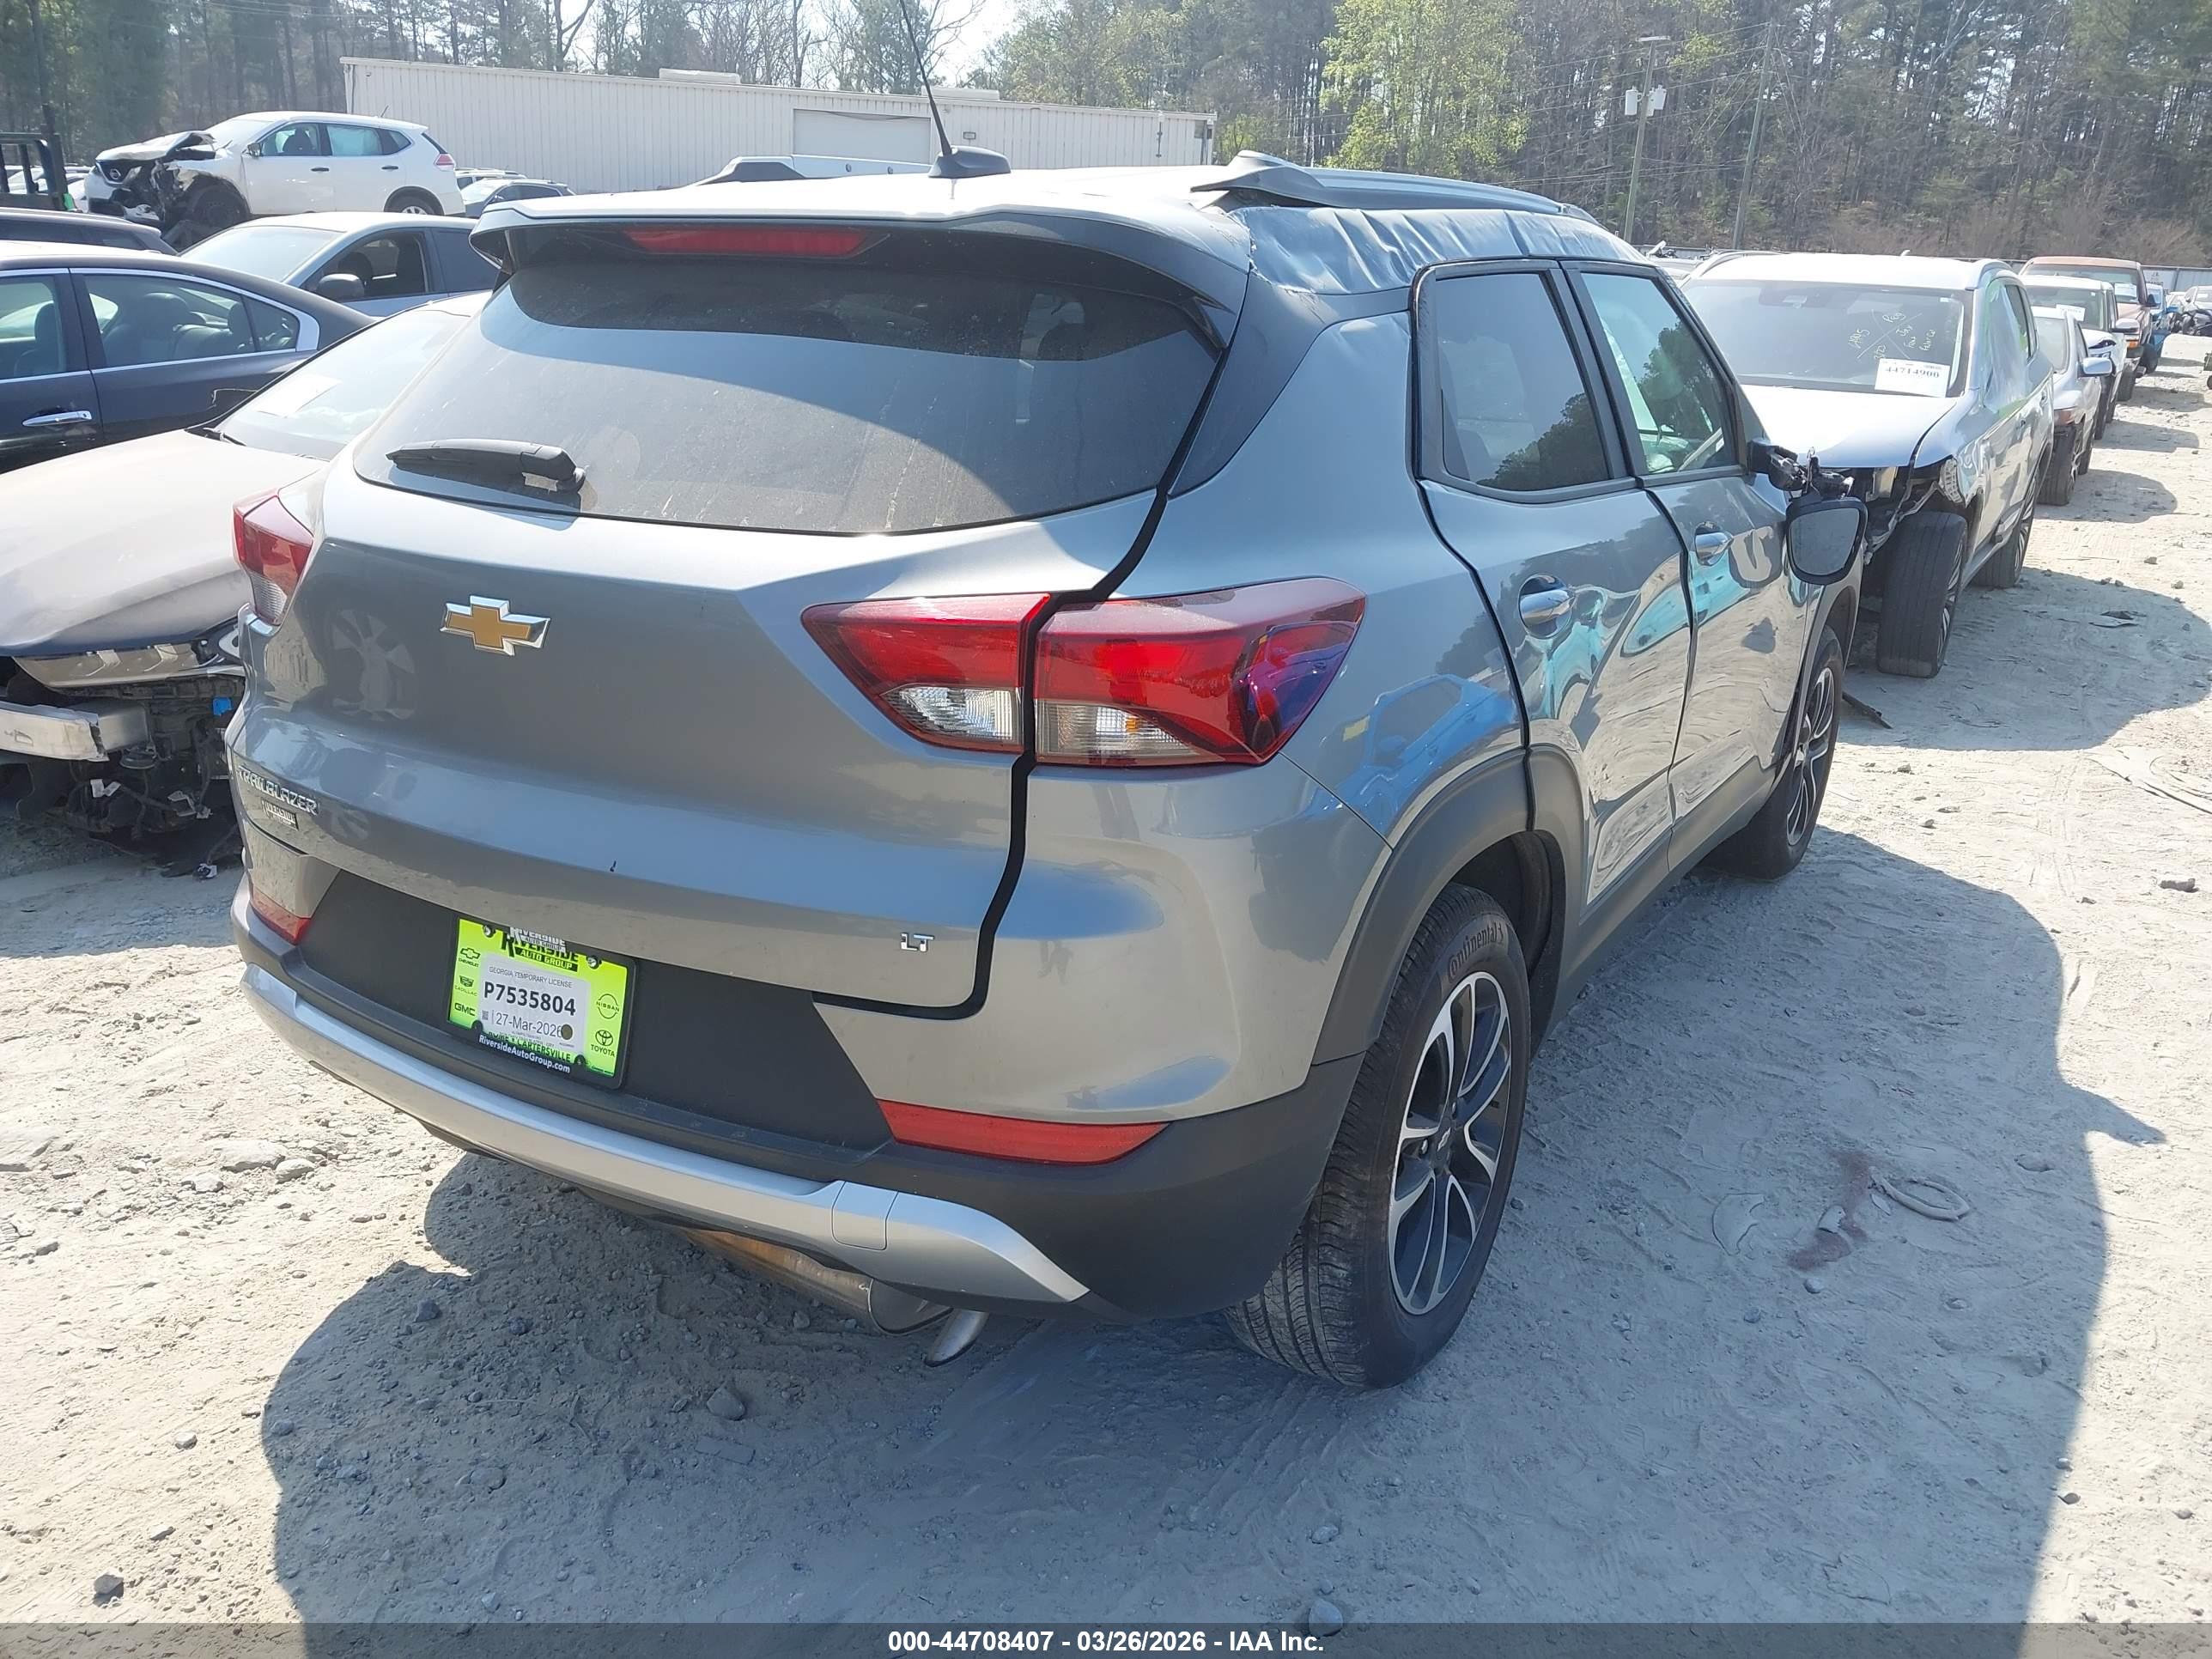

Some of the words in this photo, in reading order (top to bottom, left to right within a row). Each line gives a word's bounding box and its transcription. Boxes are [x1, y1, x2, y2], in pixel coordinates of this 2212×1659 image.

[237, 765, 319, 816] TRAILBLAZER
[900, 933, 934, 952] LT
[1448, 921, 1498, 982] Continental
[520, 950, 542, 962] AUTO
[544, 956, 573, 969] GROUP
[489, 966, 514, 977] GEORGIA
[515, 971, 547, 983] TEMPORARY
[549, 978, 573, 988] LICENSE
[455, 985, 477, 996] CADILLAC
[484, 981, 576, 1016] P7535804
[454, 1002, 476, 1017] GMC
[596, 1001, 619, 1012] NISSAN
[478, 1035, 571, 1073] RiversideAutoGroup.com
[517, 1038, 571, 1062] CARTERSVILLE
[591, 1044, 616, 1057] TOYOTA
